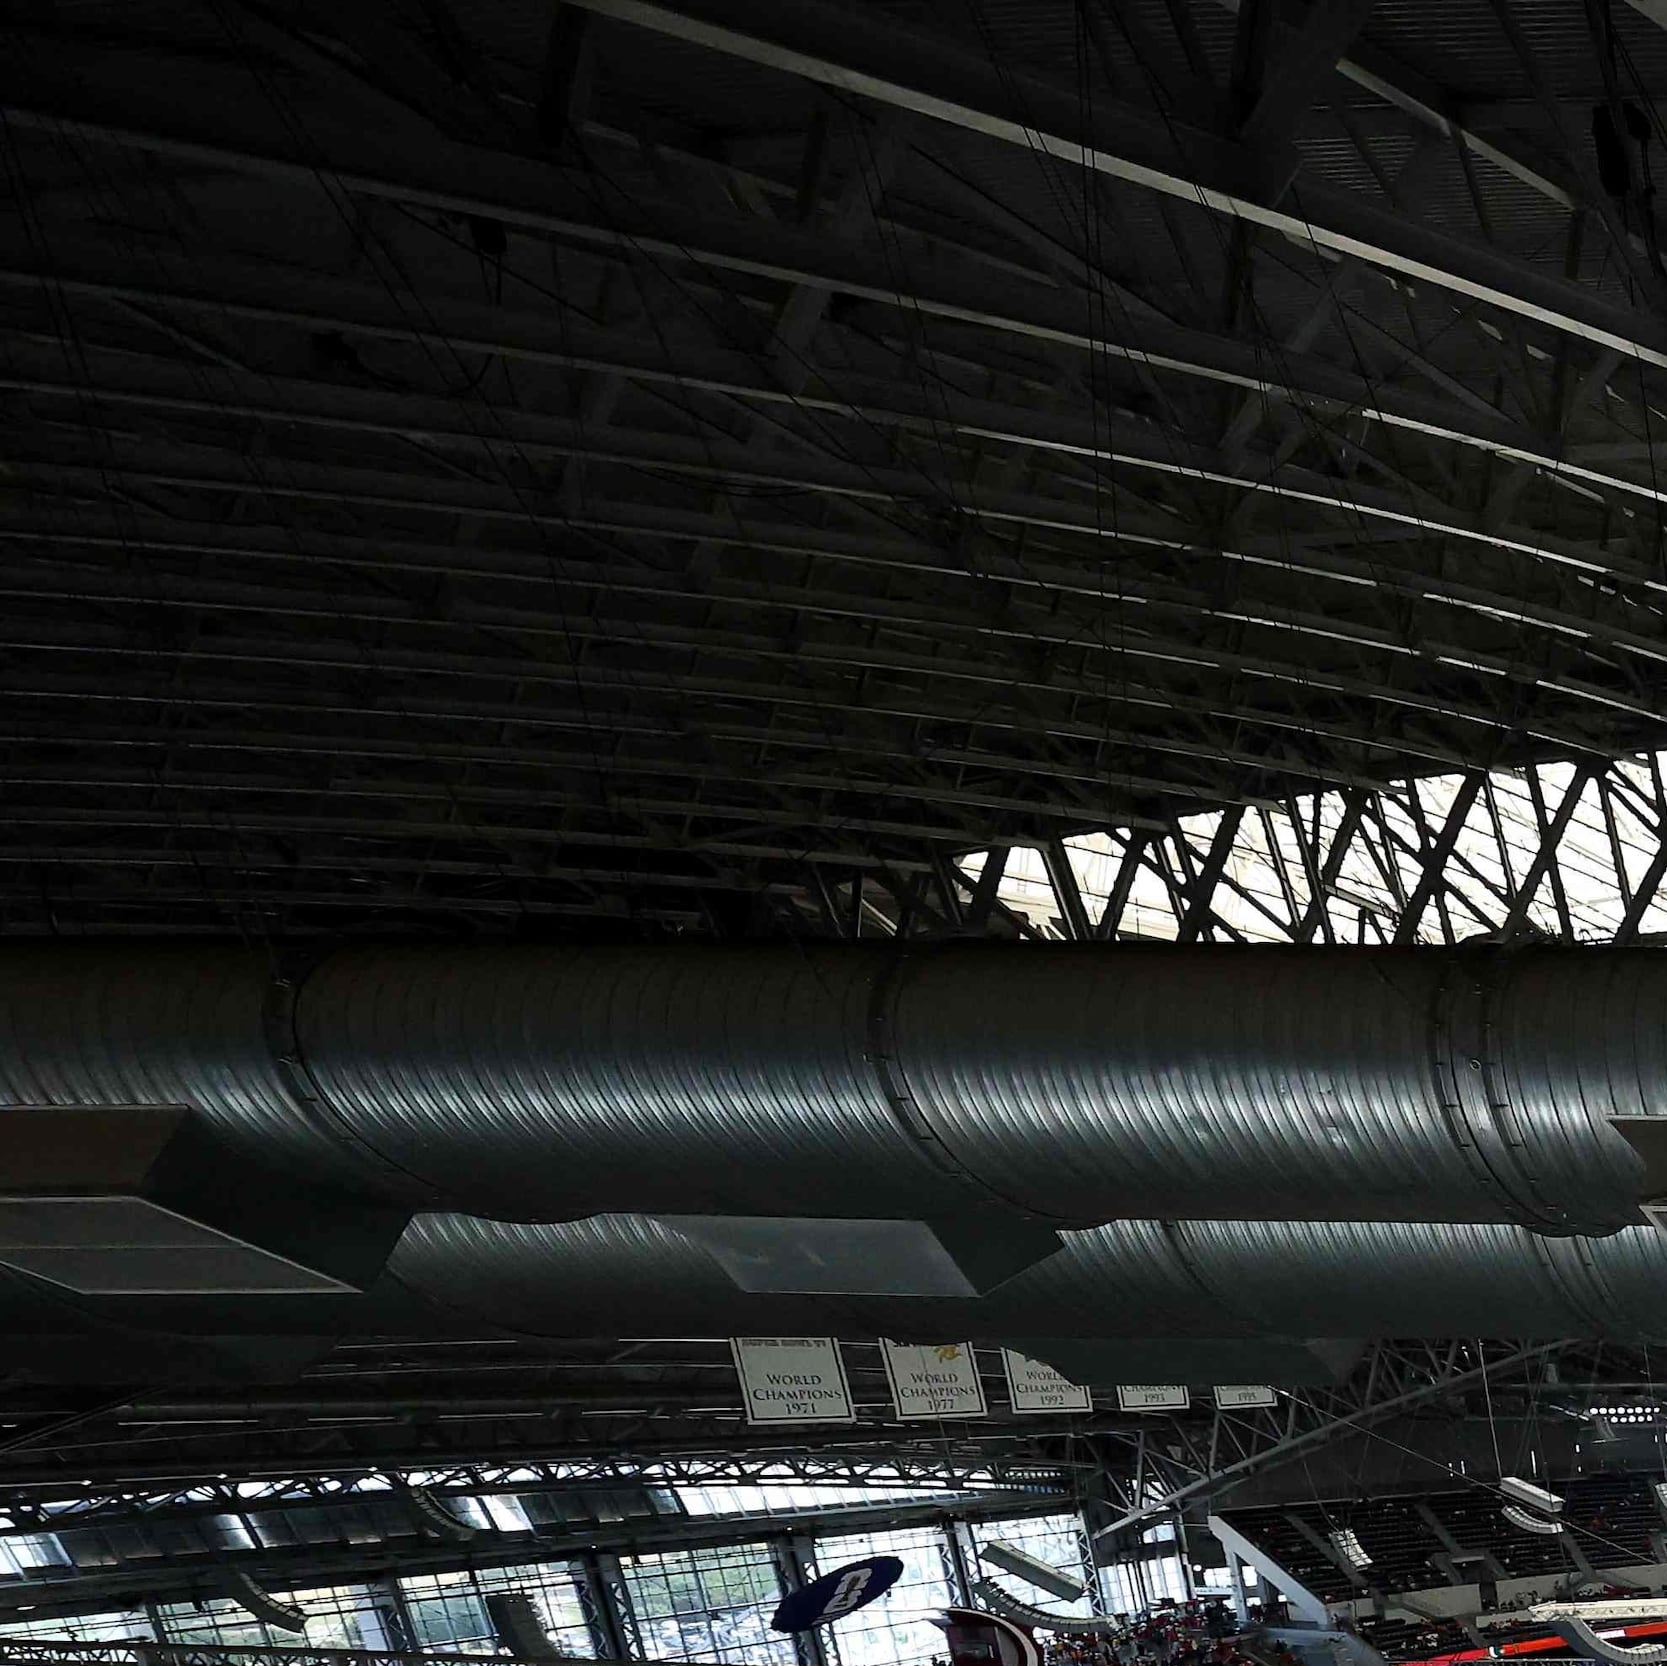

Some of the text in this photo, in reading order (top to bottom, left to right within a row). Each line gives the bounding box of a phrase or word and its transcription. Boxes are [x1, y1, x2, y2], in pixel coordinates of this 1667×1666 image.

[767, 1374, 822, 1386] WORLD
[911, 1373, 959, 1384] WORLD
[1026, 1370, 1064, 1381] WORL
[753, 1388, 842, 1401] CHAMPIONS
[901, 1386, 976, 1398] CHAMPIONS
[928, 1399, 954, 1411] 1977
[1040, 1395, 1064, 1406] 1992
[785, 1402, 817, 1414] 1971
